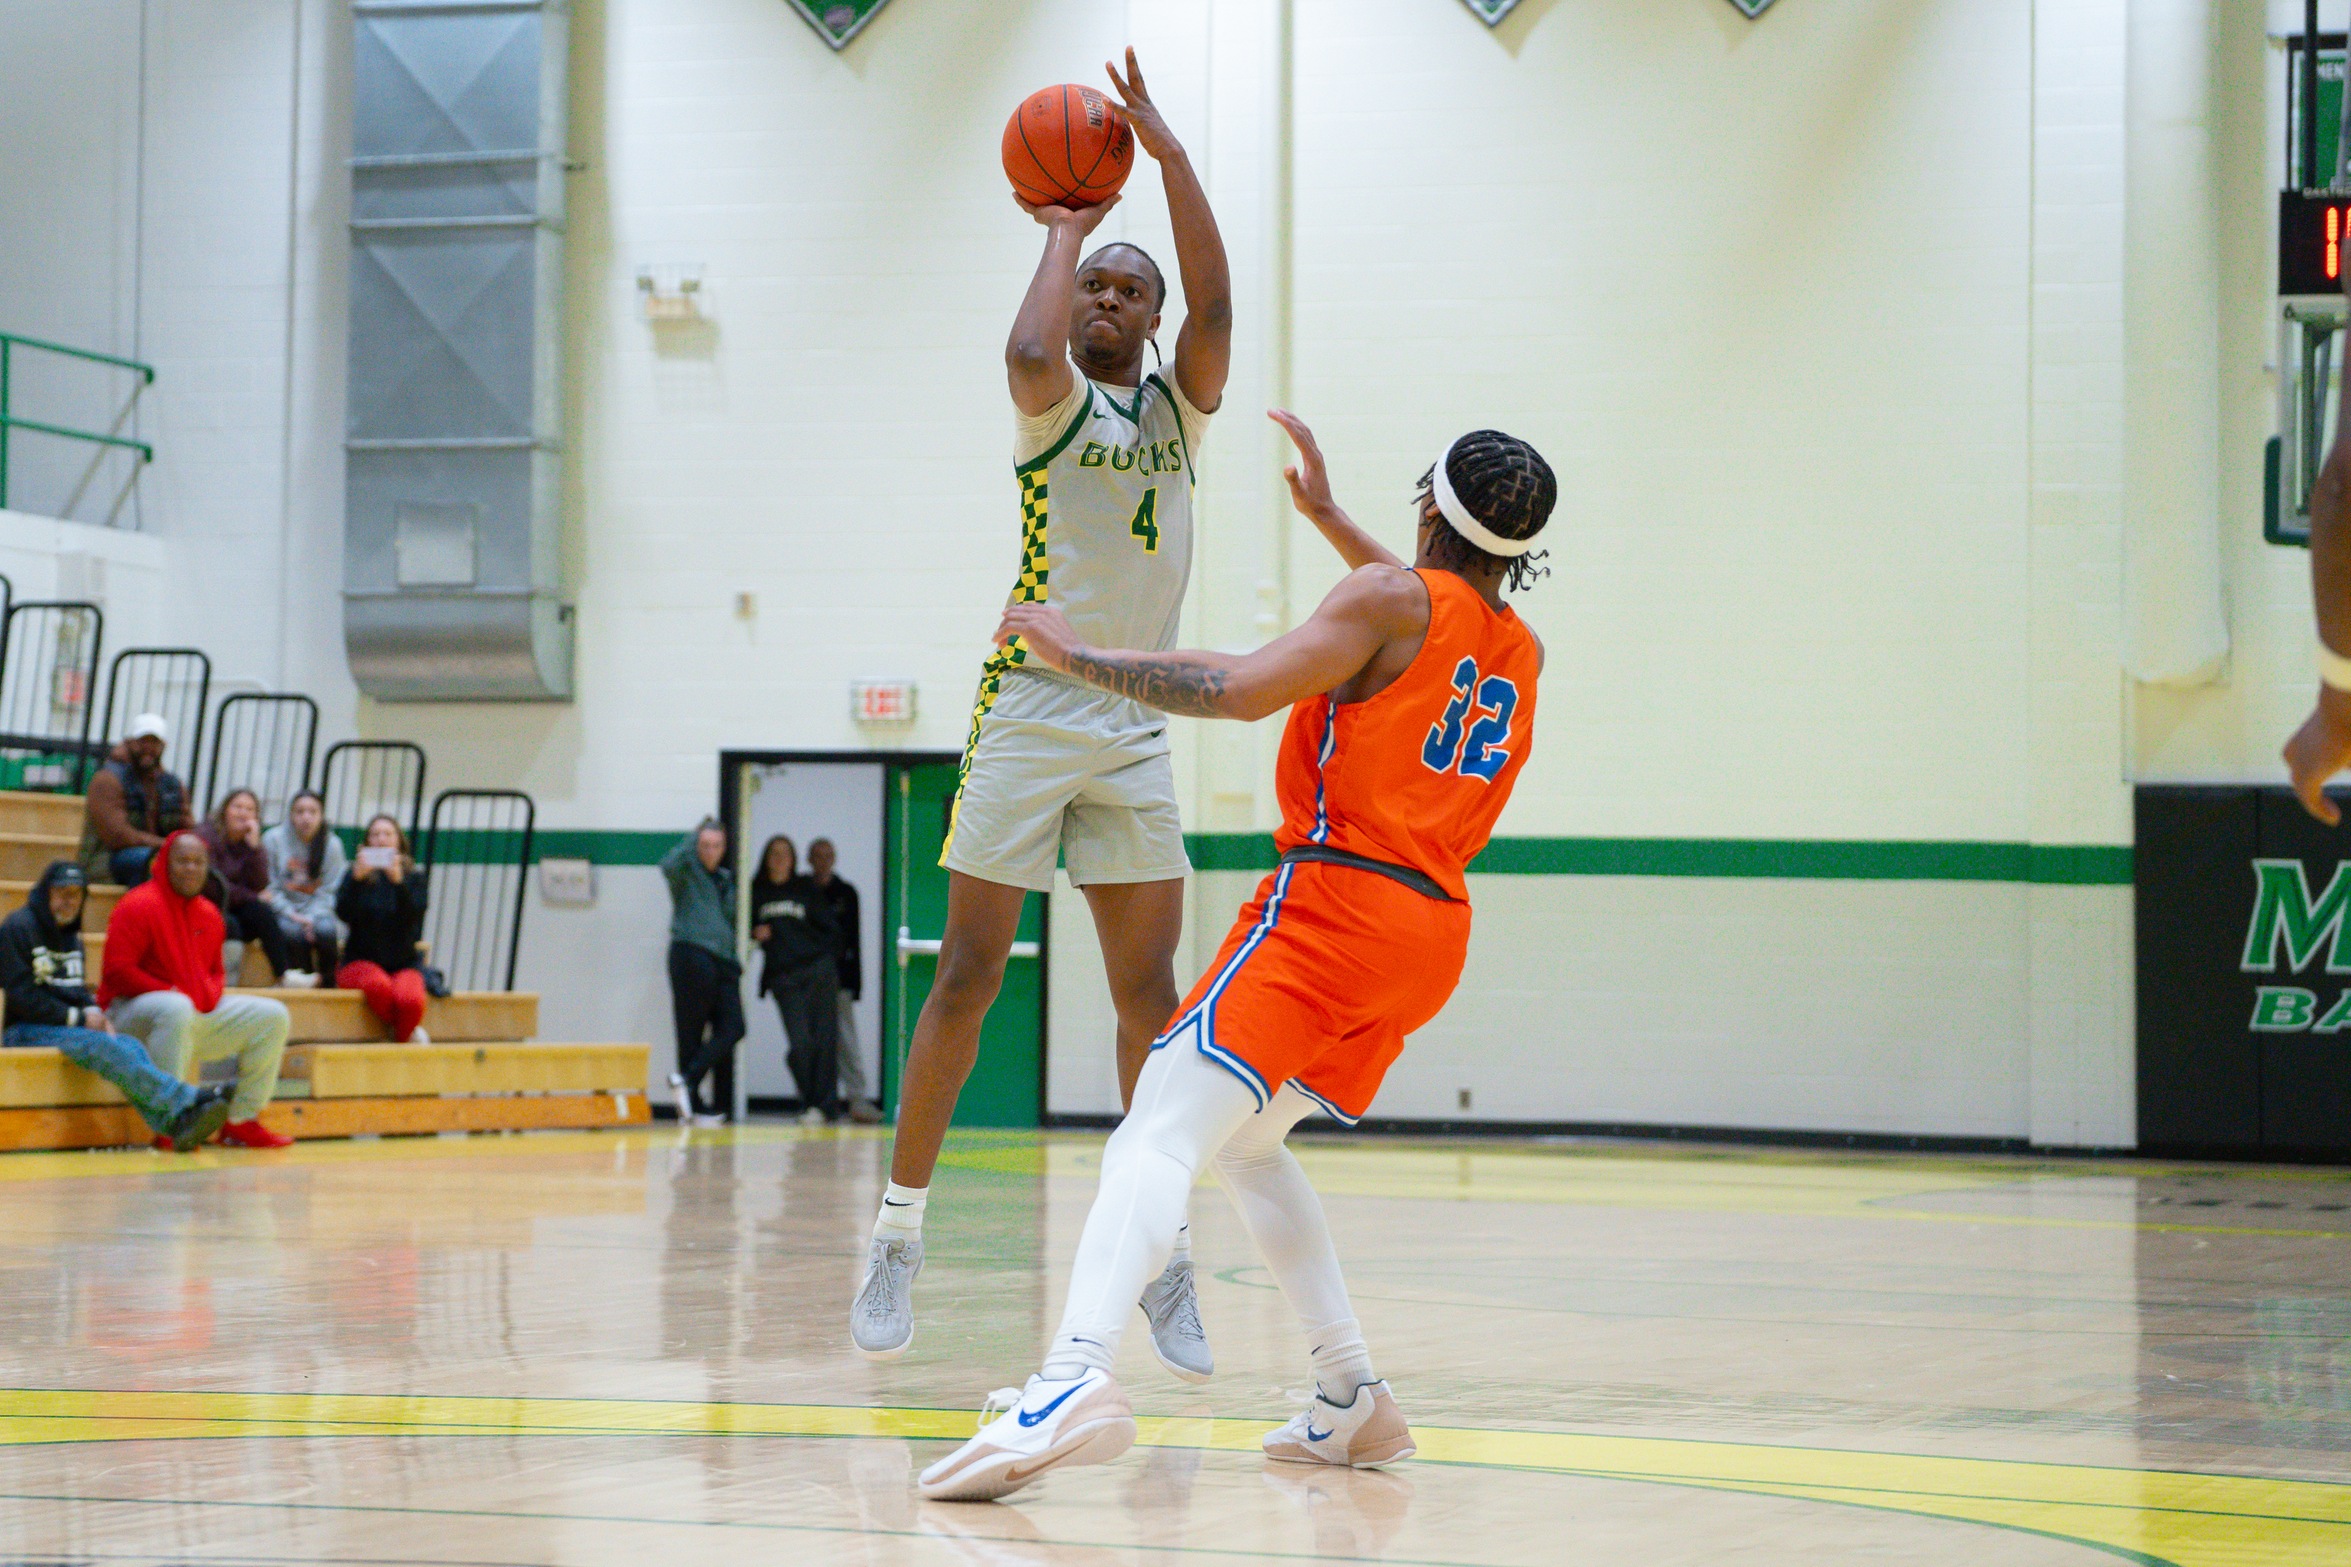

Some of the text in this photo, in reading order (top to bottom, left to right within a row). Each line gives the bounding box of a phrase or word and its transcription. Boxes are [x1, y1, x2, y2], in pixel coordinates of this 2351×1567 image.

[1078, 438, 1183, 477] BUCKS
[1129, 486, 1161, 556] 4
[1421, 654, 1520, 785] 32
